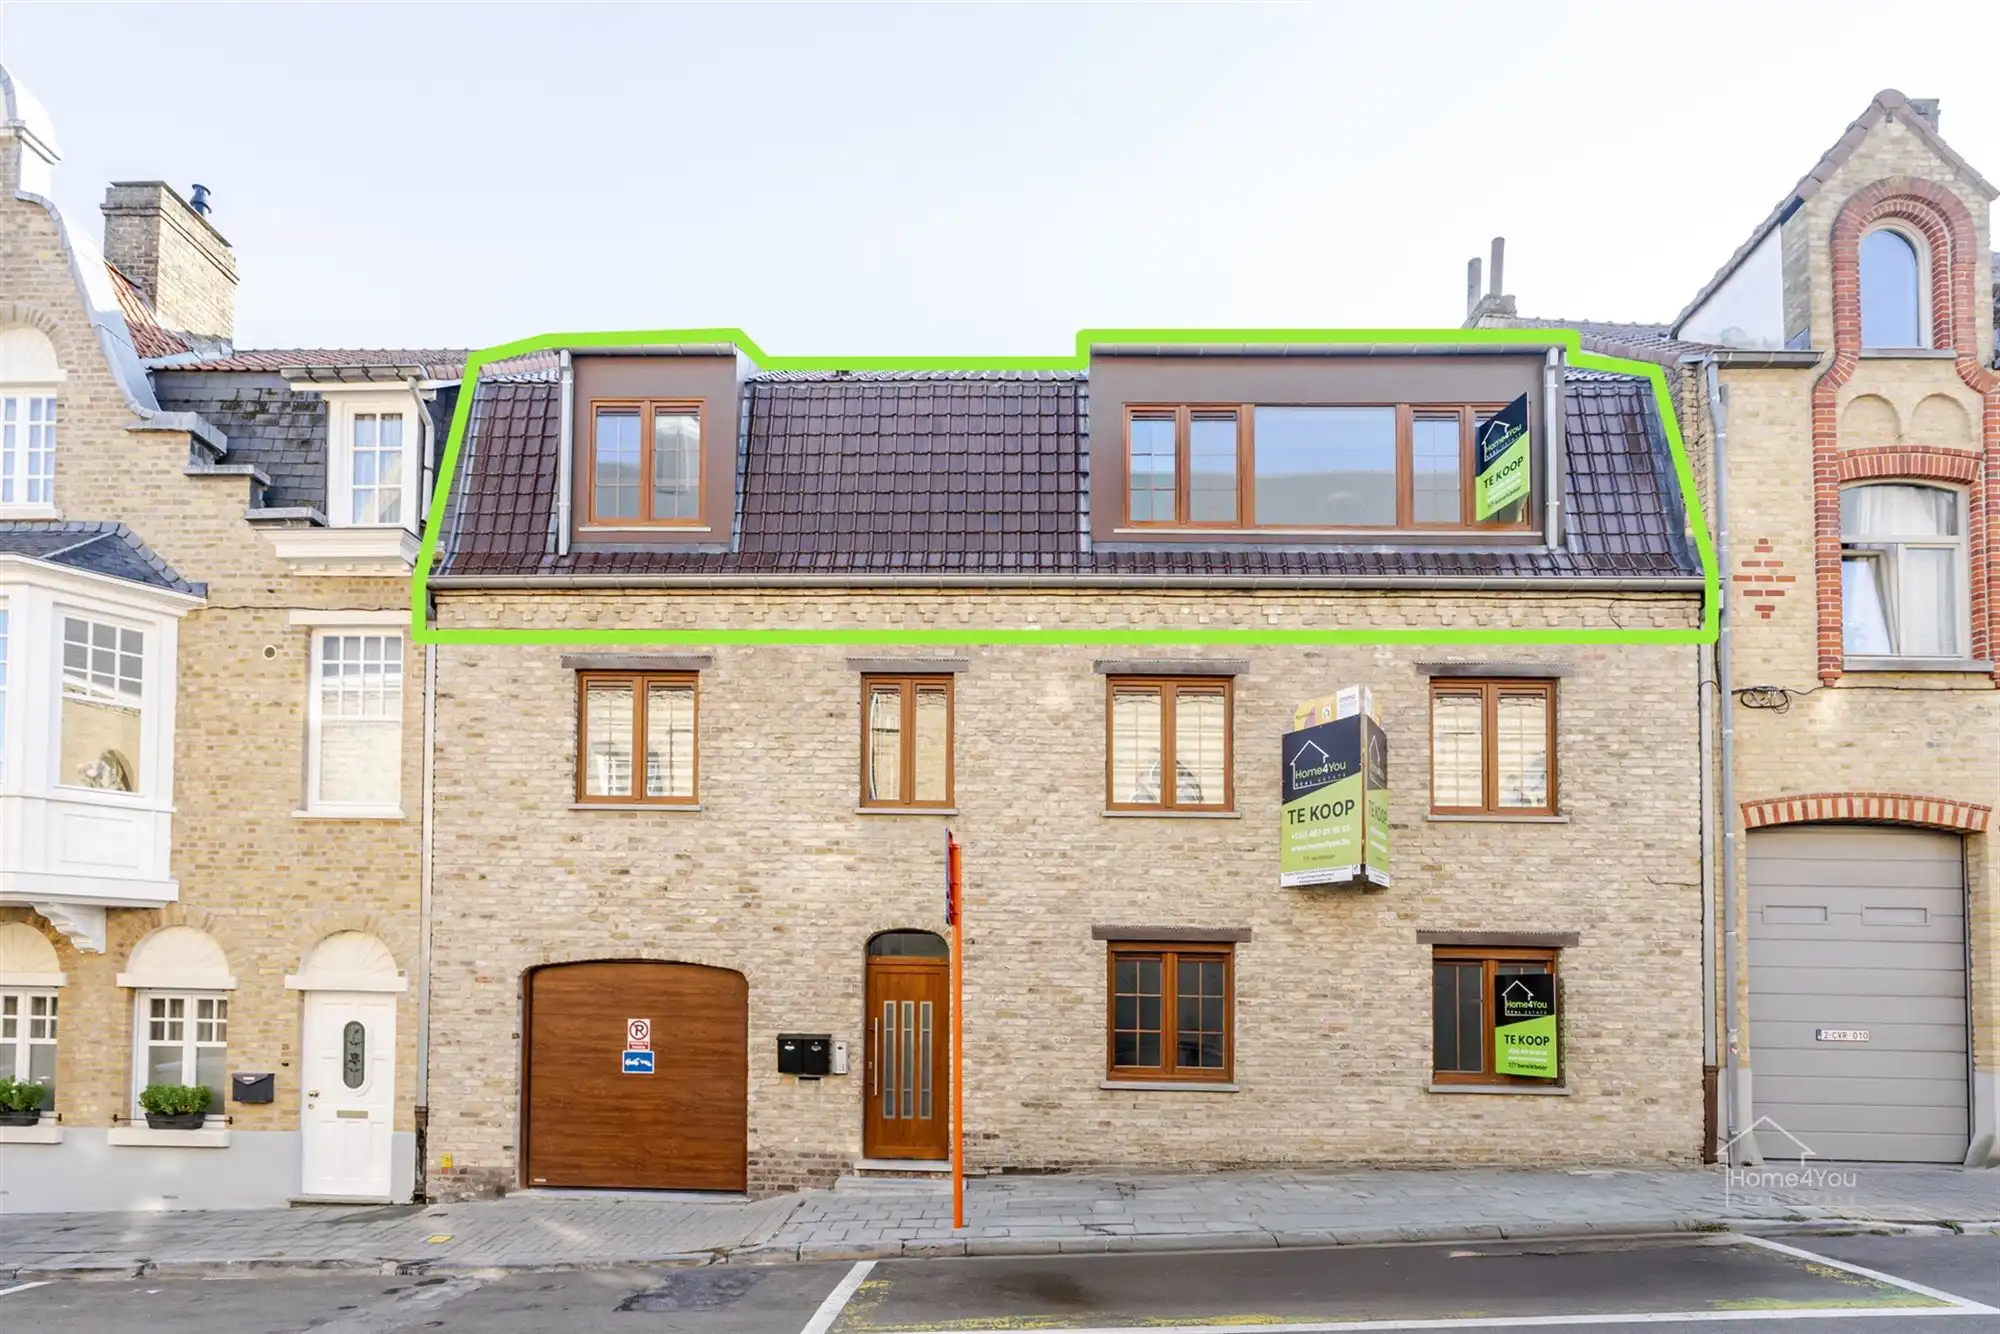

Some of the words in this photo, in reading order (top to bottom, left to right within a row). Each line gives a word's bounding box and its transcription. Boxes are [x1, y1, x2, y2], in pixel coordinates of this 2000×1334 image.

[1483, 475, 1494, 488] TE
[1496, 456, 1524, 481] KOOP
[1295, 761, 1347, 779] Home4You
[1288, 808, 1306, 825] TE
[1310, 799, 1355, 822] KOOP
[1506, 1001, 1548, 1009] Home4You
[1504, 1034, 1516, 1045] TE
[1518, 1035, 1550, 1046] KOOP
